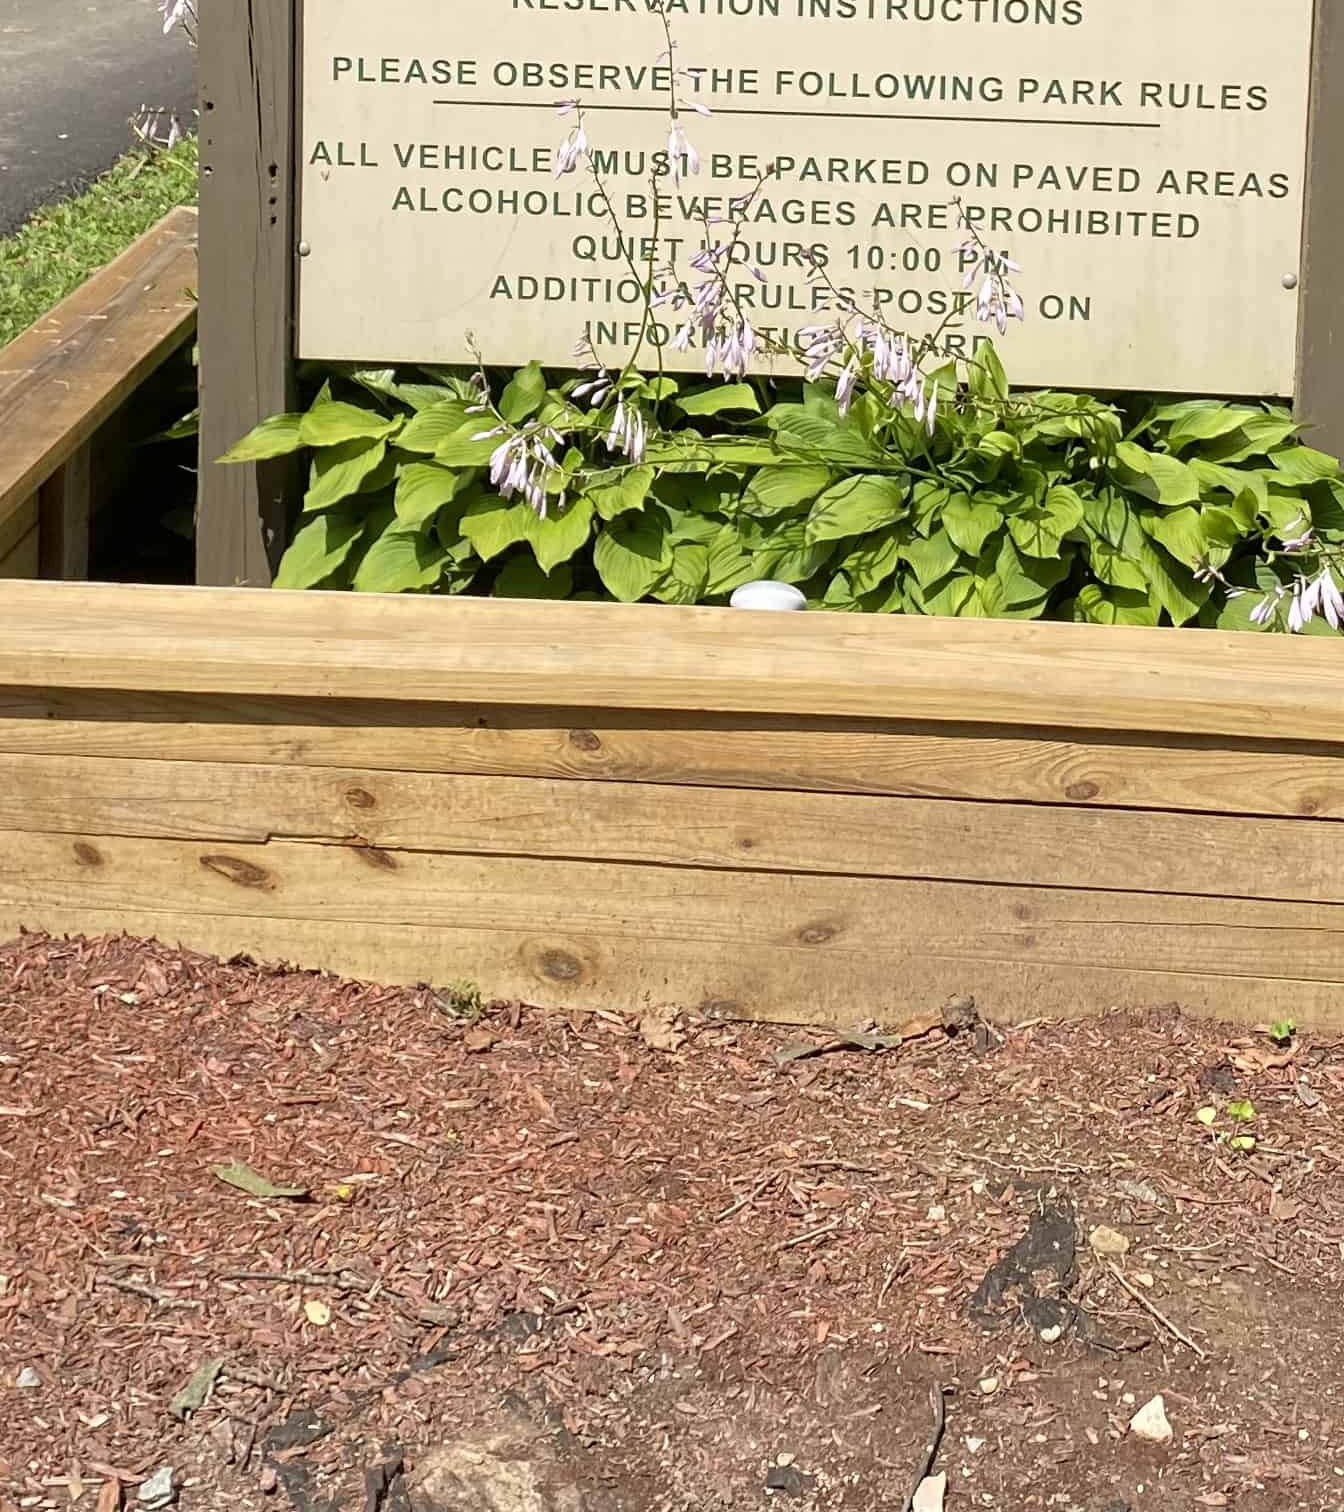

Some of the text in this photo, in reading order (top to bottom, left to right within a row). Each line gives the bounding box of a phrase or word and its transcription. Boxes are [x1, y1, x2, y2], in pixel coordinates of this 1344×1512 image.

[334, 57, 1267, 111] PLEASE OBSERVE THE FOLLOWING PARK RULES
[310, 141, 378, 167] ALL
[393, 144, 577, 173] VEHICLE
[712, 154, 759, 180] BE
[775, 156, 930, 185] PARKED
[947, 162, 997, 187] ON
[1014, 164, 1139, 192] PAVED
[1156, 170, 1288, 198] AREAS
[392, 187, 1199, 238] ALCOHOLIC BEVERAGES ARE PROHIBITED
[573, 236, 683, 263] QUIET
[848, 245, 940, 272] 10:00
[959, 250, 1009, 275] PM
[490, 275, 1090, 320] ADDITIOA RULES POST ON
